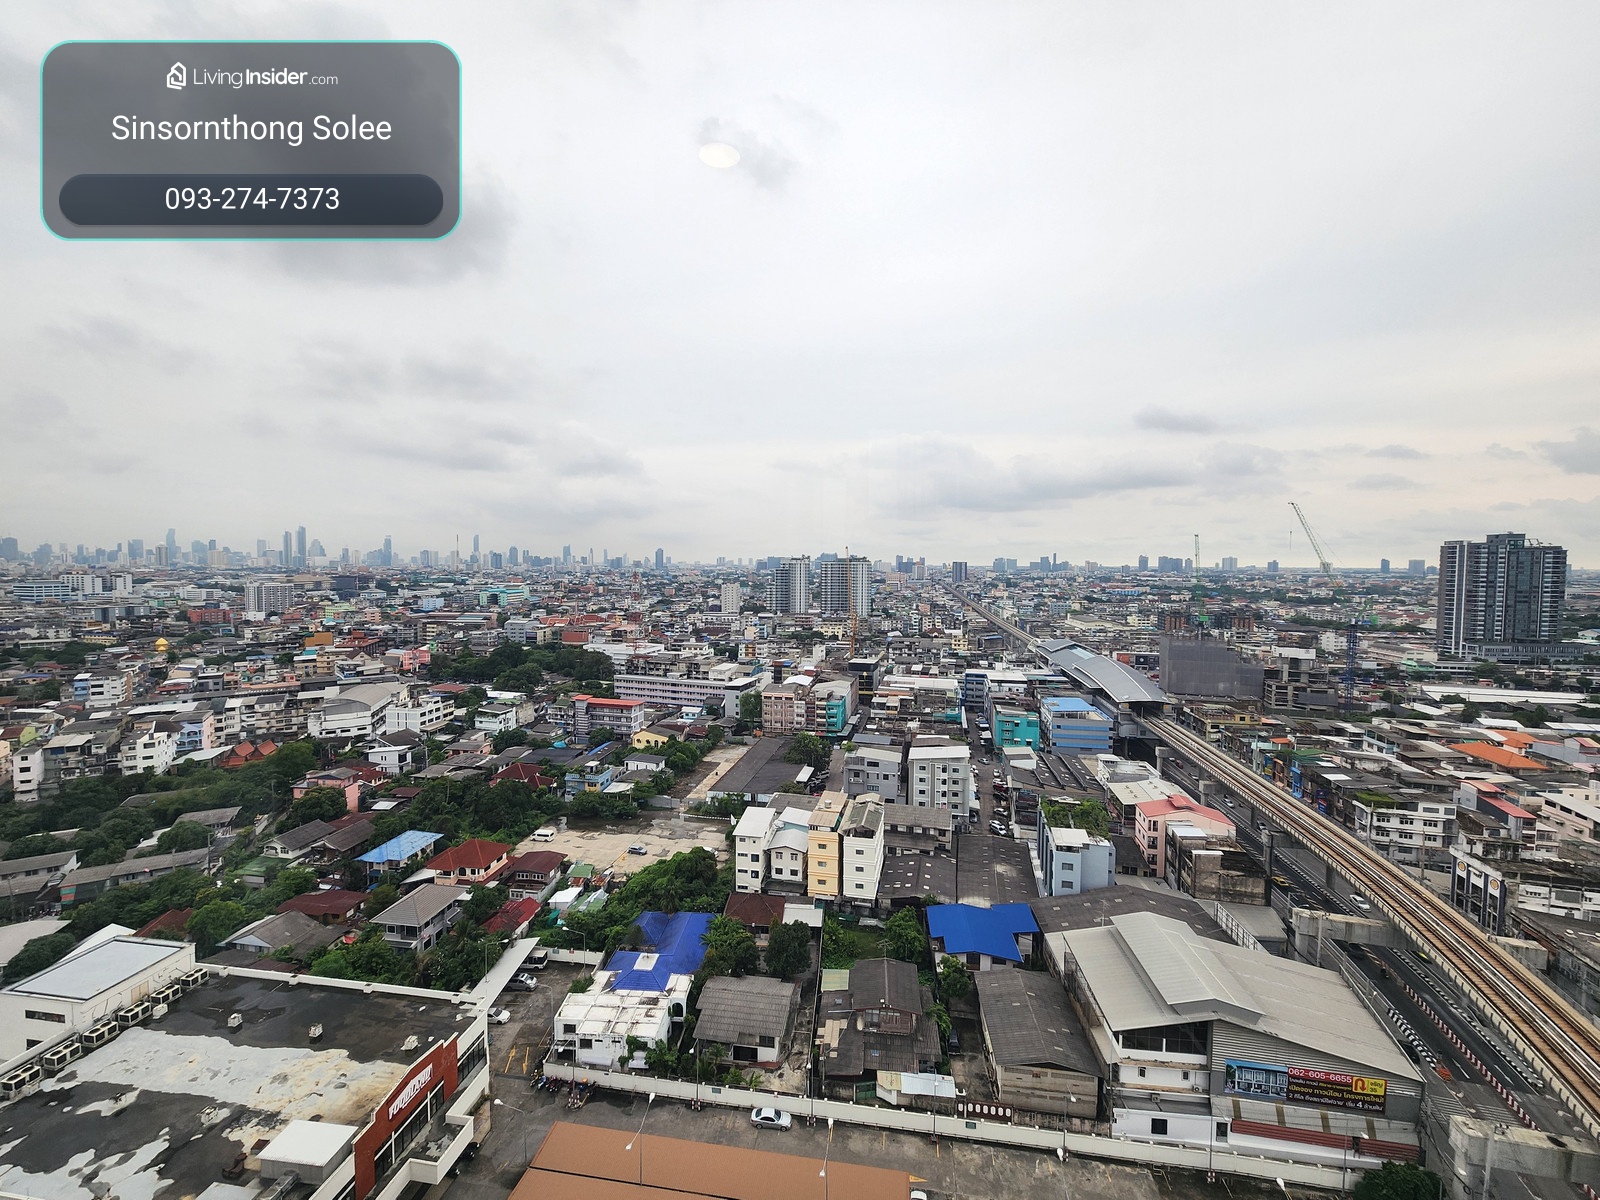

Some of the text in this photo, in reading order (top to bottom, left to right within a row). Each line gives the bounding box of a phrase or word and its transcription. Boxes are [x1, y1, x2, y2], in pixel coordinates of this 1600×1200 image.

[1288, 1068, 1352, 1082] 062-605-6655
[1288, 1084, 1312, 1093] เปิดจอง
